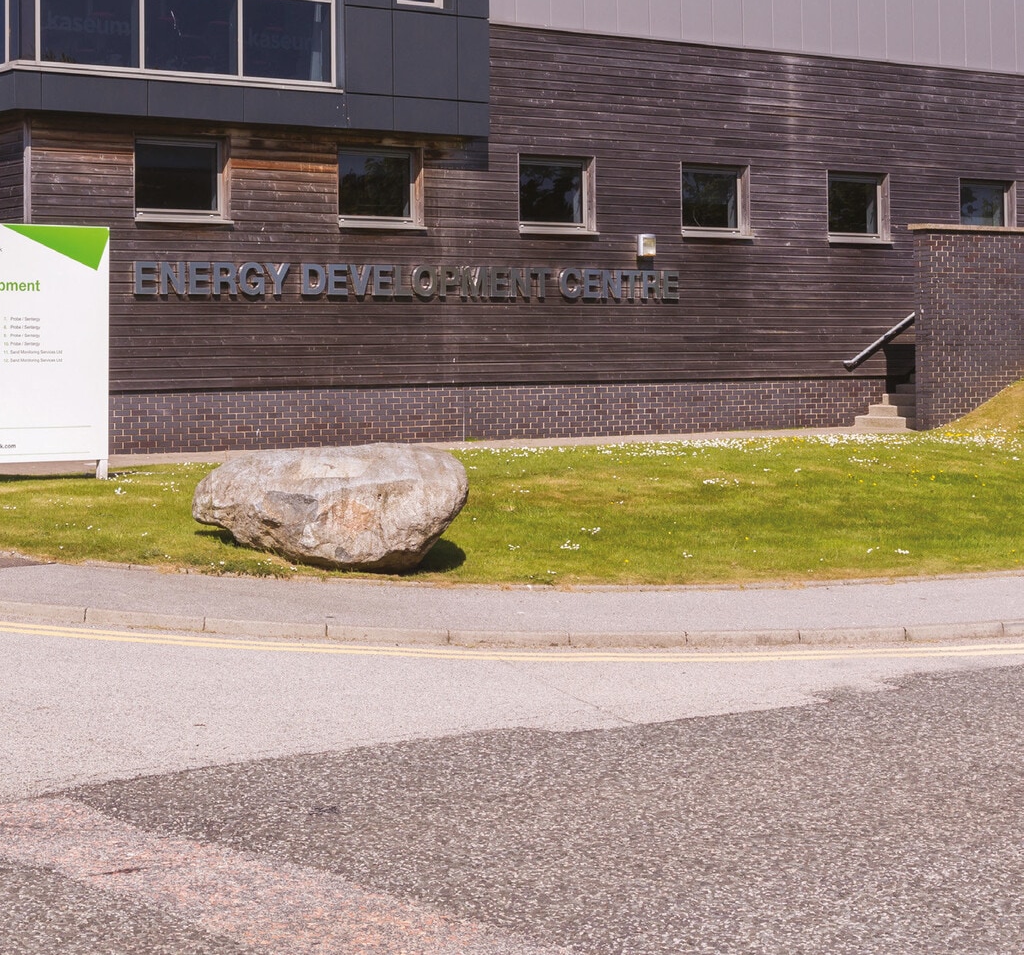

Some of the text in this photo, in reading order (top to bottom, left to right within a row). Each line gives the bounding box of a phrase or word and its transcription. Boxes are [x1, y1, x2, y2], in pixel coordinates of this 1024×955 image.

[47, 11, 131, 37] kaseum
[134, 261, 680, 301] ENERGY DEVELOPMENT CENTRE
